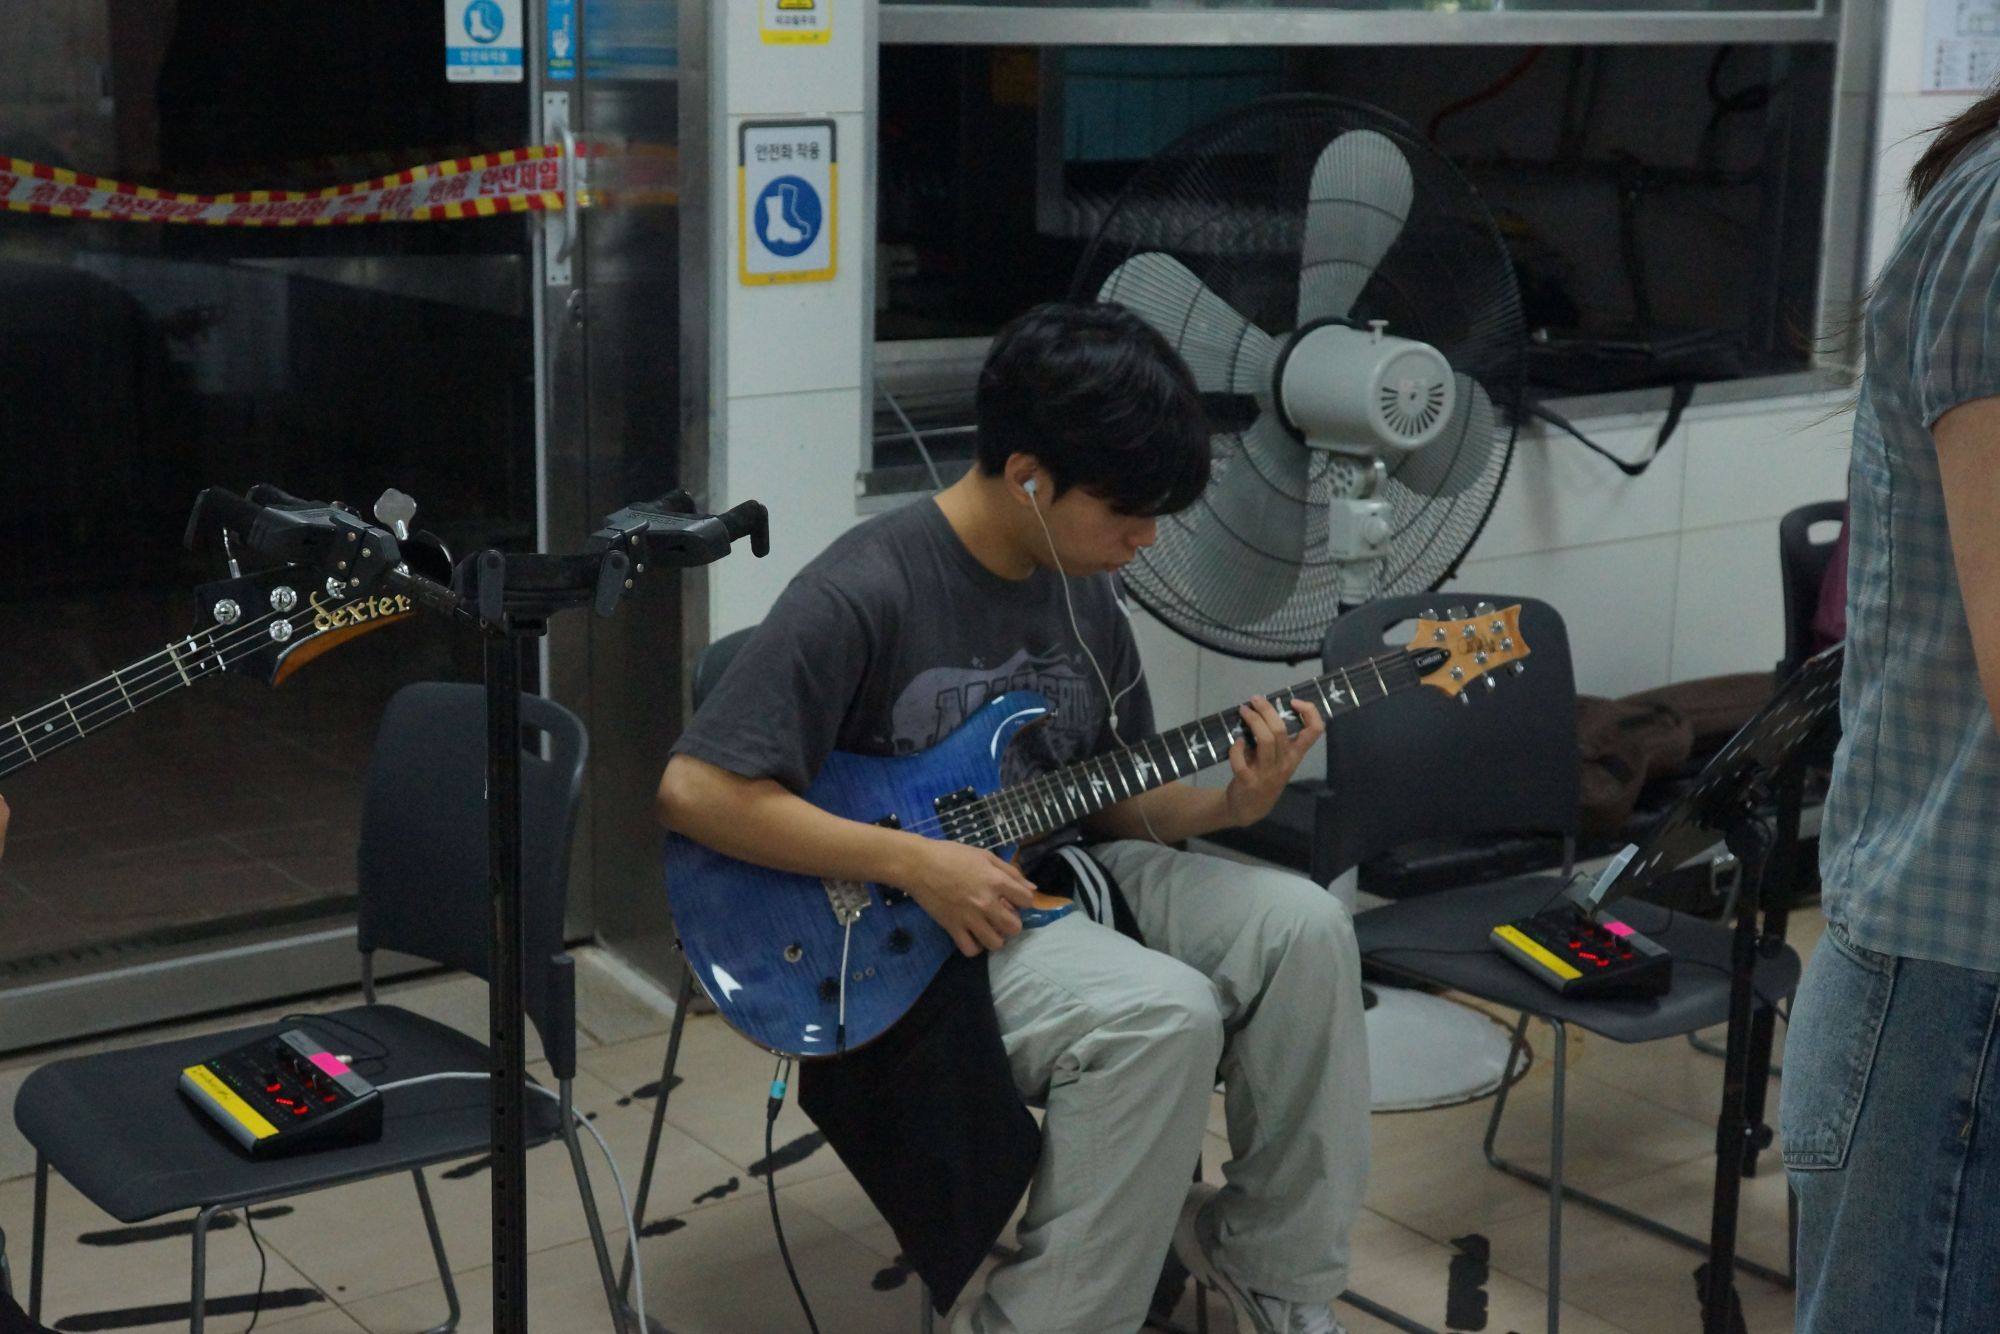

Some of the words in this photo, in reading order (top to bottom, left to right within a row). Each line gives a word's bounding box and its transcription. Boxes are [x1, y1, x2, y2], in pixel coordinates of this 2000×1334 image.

[754, 142, 793, 162] 안전화
[796, 141, 821, 160] 착용
[478, 160, 560, 196] 안전제일
